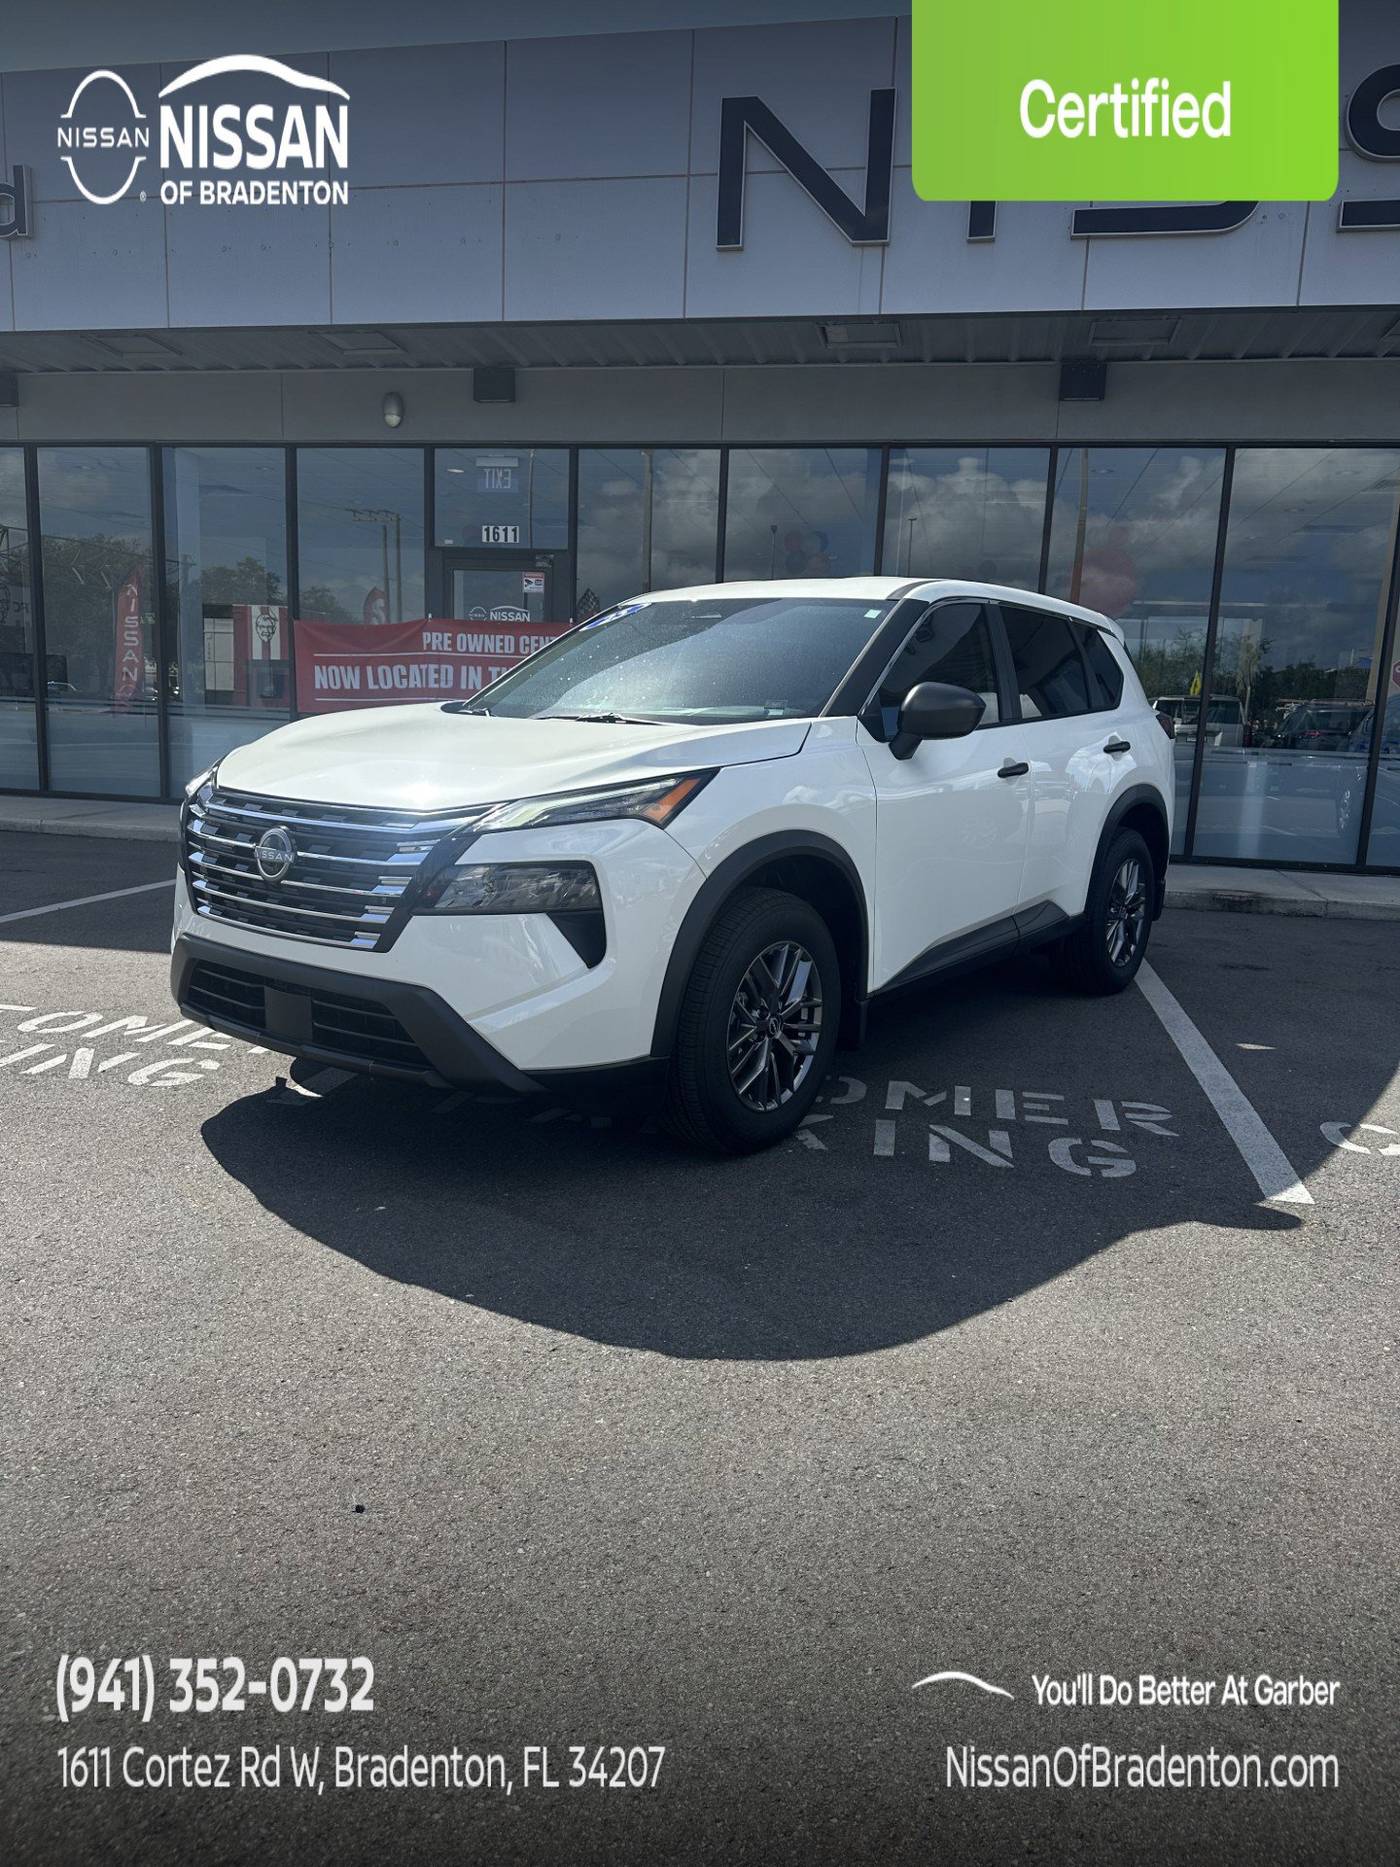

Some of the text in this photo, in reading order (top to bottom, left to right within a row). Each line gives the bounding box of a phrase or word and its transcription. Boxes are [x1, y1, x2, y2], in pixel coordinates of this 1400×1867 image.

[483, 526, 519, 543] 1611
[489, 611, 530, 622] NISSAN
[422, 631, 452, 651] PRE
[456, 633, 516, 654] OWNED
[314, 665, 361, 690] NOW
[366, 663, 453, 690] LOCATED
[460, 665, 482, 690] IN
